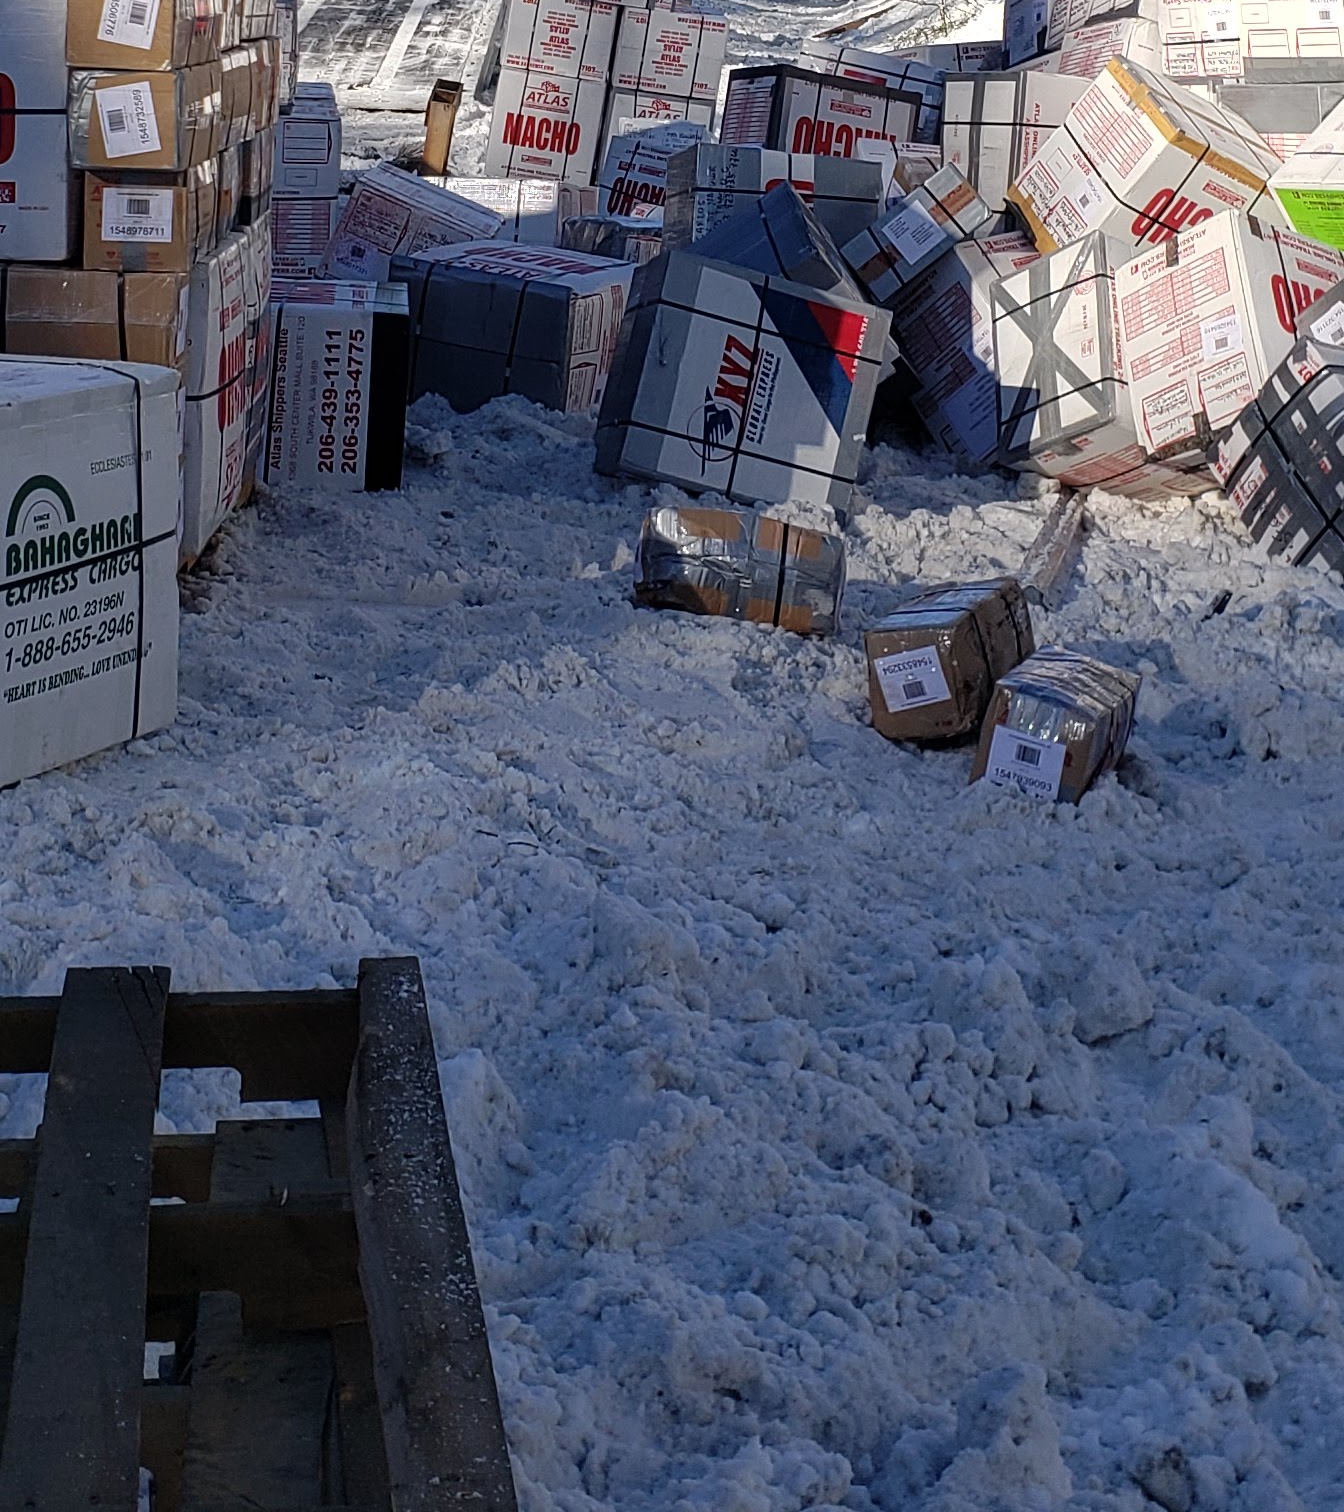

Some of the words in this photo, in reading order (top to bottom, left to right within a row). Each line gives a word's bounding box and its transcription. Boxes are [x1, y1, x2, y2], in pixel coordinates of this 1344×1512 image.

[548, 35, 570, 46] ATLAS
[549, 24, 570, 34] ATLAS
[660, 53, 682, 64] ATLAS
[662, 43, 684, 54] ATLAS
[132, 89, 151, 145] 1548732589
[526, 92, 571, 108] ATLAS
[502, 111, 582, 156] MACHO
[792, 115, 897, 159] CHO
[108, 225, 165, 237] 1548978711
[298, 316, 306, 333] 120
[278, 328, 289, 372] Seattle
[296, 335, 305, 361] SUITE
[294, 363, 303, 388] MALL
[714, 334, 758, 408] XYZ
[273, 377, 286, 434] Shippers
[291, 389, 300, 426] CENTER
[309, 387, 317, 402] WA
[317, 329, 342, 474] 206-439-1111
[341, 328, 365, 474] 206-353-4775
[746, 403, 764, 443] GLOBAL
[756, 350, 775, 399] EXPRESS
[270, 438, 283, 471] Atlas
[289, 427, 298, 459] SOUTH
[33, 512, 50, 523] SINCE
[6, 512, 140, 577] BAHAGHARI
[5, 567, 79, 607] EXPRESS
[88, 552, 140, 586] CARGO
[4, 619, 27, 639] OTI
[58, 605, 80, 626] NO.
[83, 591, 125, 618] 23196N
[4, 611, 135, 672] 1-888-655-2946
[37, 677, 47, 693] IS
[91, 657, 112, 677] LOVE
